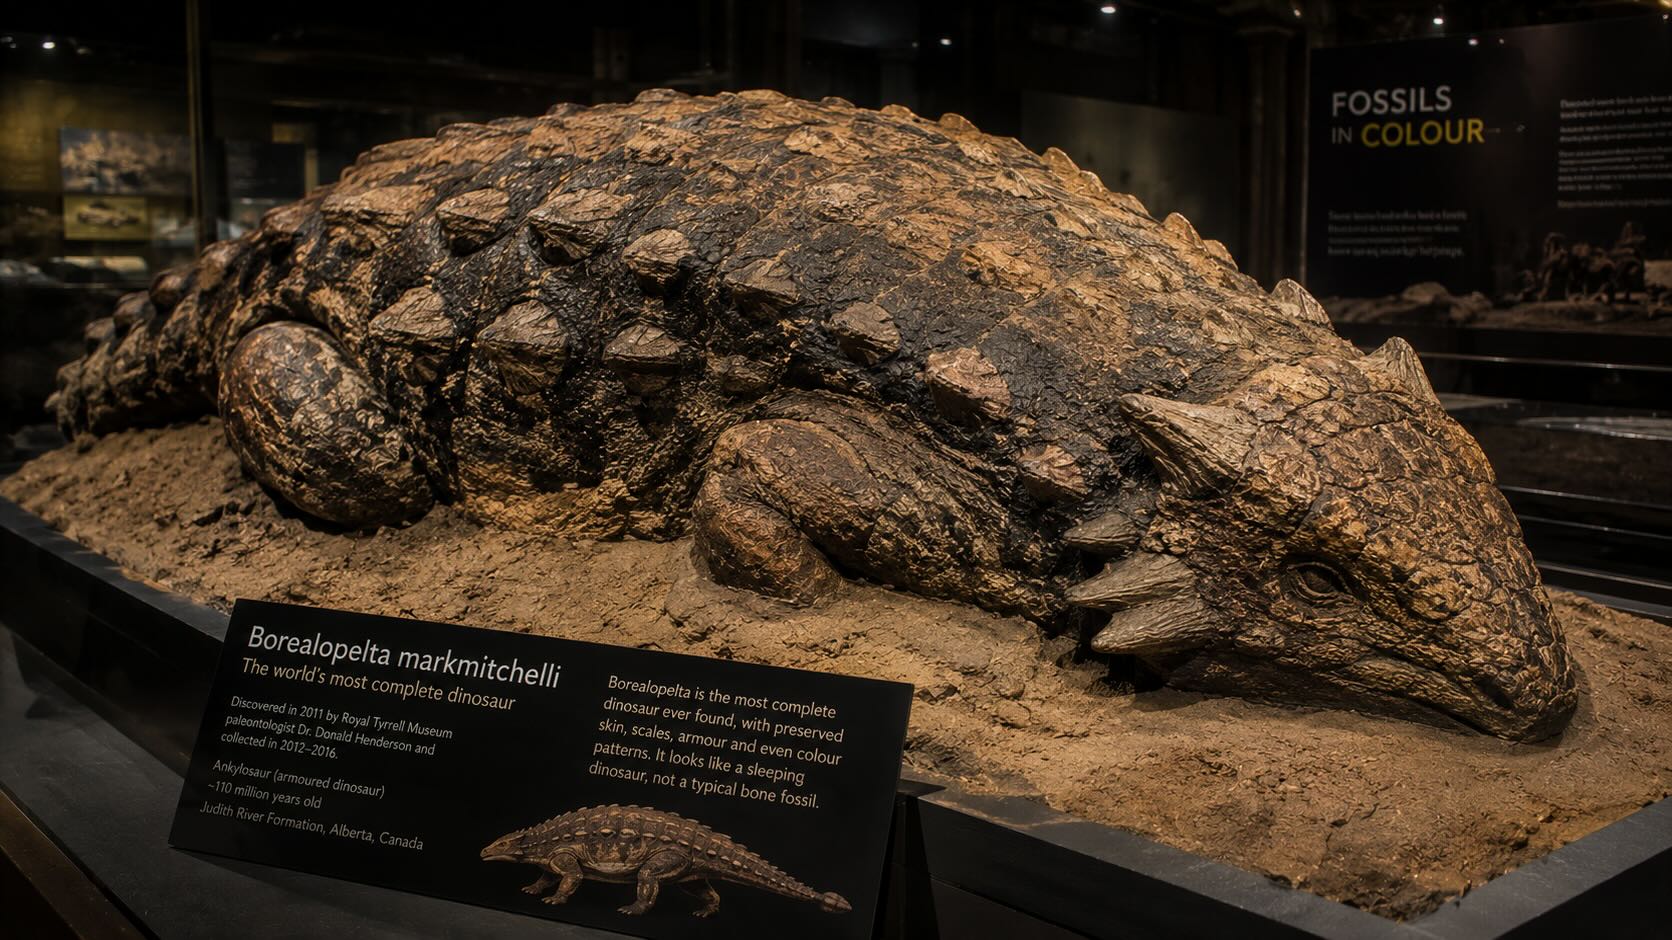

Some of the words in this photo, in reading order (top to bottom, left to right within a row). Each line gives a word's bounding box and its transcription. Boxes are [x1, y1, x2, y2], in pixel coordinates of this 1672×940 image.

[1332, 85, 1452, 117] FOSSILS
[1331, 127, 1352, 144] IN
[1361, 117, 1485, 148] COLOUR
[248, 625, 391, 666] Borealopelta
[397, 649, 562, 689] markmitchelli
[243, 657, 269, 676] The
[274, 665, 327, 684] world's
[329, 674, 369, 690] most
[371, 680, 444, 701] complete
[447, 686, 517, 711] dinosaur
[608, 675, 692, 699] Borealopelta
[694, 686, 706, 701] is
[709, 688, 731, 705] the
[734, 696, 769, 710] most
[772, 701, 837, 719] complete
[225, 715, 296, 735] paleontologist
[297, 723, 312, 737] Dr.
[315, 726, 354, 743] Donald
[355, 733, 412, 752] Henderson
[415, 744, 436, 756] and
[231, 696, 287, 714] Discovered
[288, 704, 298, 716] in
[300, 705, 324, 720] 2011
[326, 710, 340, 725] by
[341, 712, 371, 729] Royal
[373, 716, 406, 732] Tyrrell
[407, 722, 453, 739] Museum
[603, 696, 661, 717] dinosaur
[662, 708, 692, 721] ever
[695, 708, 737, 730] found,
[742, 717, 771, 733] with
[773, 724, 845, 743] preserved
[221, 732, 267, 748] collected
[268, 738, 278, 749] in
[598, 718, 628, 737] skin,
[631, 724, 674, 743] scales,
[678, 732, 729, 749] armour
[730, 739, 758, 753] and
[760, 745, 793, 759] even
[797, 748, 843, 766] colour
[213, 760, 272, 779] Ankylosaur
[274, 769, 332, 789] (armoured
[333, 779, 385, 800] dinosaur)
[589, 760, 648, 785] dinosaur,
[653, 774, 677, 787] not
[679, 778, 688, 789] a
[691, 778, 738, 796] typical
[740, 783, 777, 803] bone
[781, 789, 820, 809] fossil.
[593, 743, 651, 761] patterns.
[656, 747, 667, 763] It
[669, 749, 705, 768] looks
[708, 755, 732, 773] like
[735, 764, 744, 775] a
[747, 762, 806, 787] sleeping
[208, 781, 233, 794] ~110
[234, 785, 270, 800] million
[272, 793, 301, 806] years
[304, 796, 323, 809] old
[200, 801, 234, 817] Judith
[237, 807, 265, 823] River
[267, 812, 326, 834] Formation,
[329, 824, 375, 843] Alberta,
[380, 832, 424, 851] Canada
